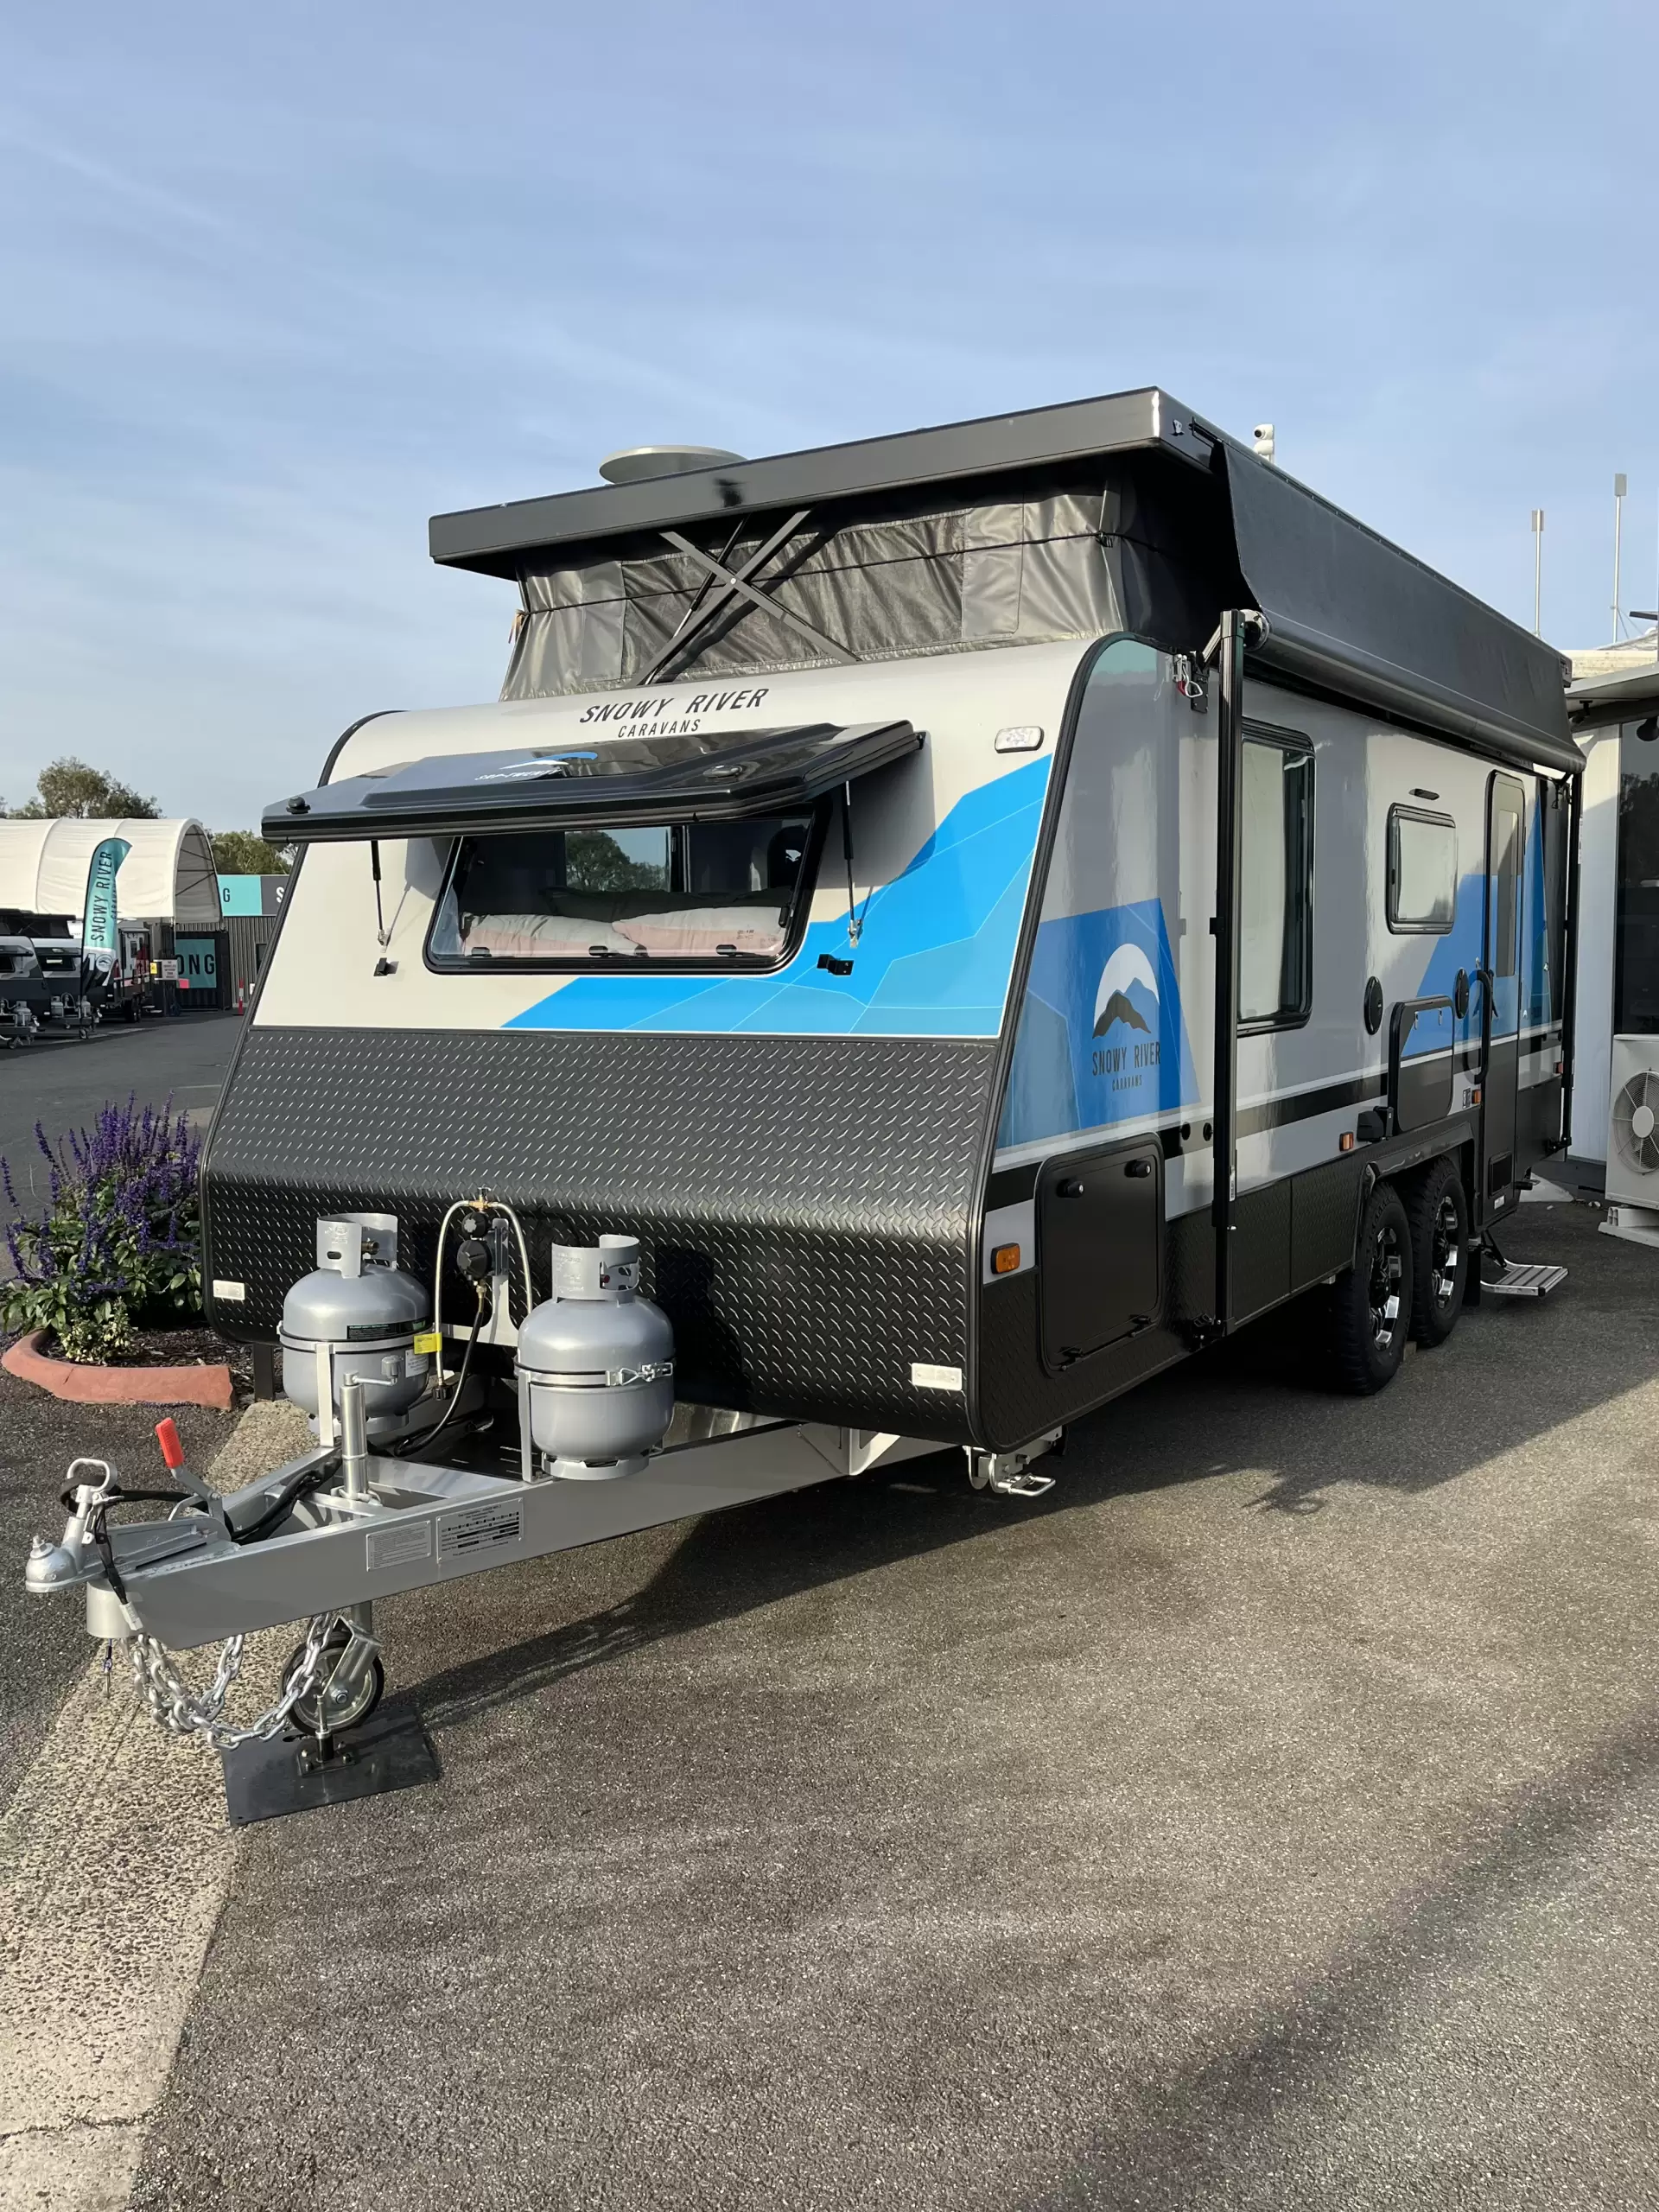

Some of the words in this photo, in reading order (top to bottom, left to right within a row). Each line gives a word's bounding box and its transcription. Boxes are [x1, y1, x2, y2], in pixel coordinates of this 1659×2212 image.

[580, 697, 675, 723] SNOWY
[685, 688, 770, 714] RIVER
[618, 719, 701, 738] CARAVANS
[96, 851, 112, 890] RIVER
[223, 887, 231, 903] G
[276, 886, 285, 904] S
[91, 895, 108, 942] SNOWY
[1092, 1046, 1127, 1077] SNOWY
[1134, 1041, 1160, 1069] RIVER
[1112, 1074, 1142, 1092] CARAVANS
